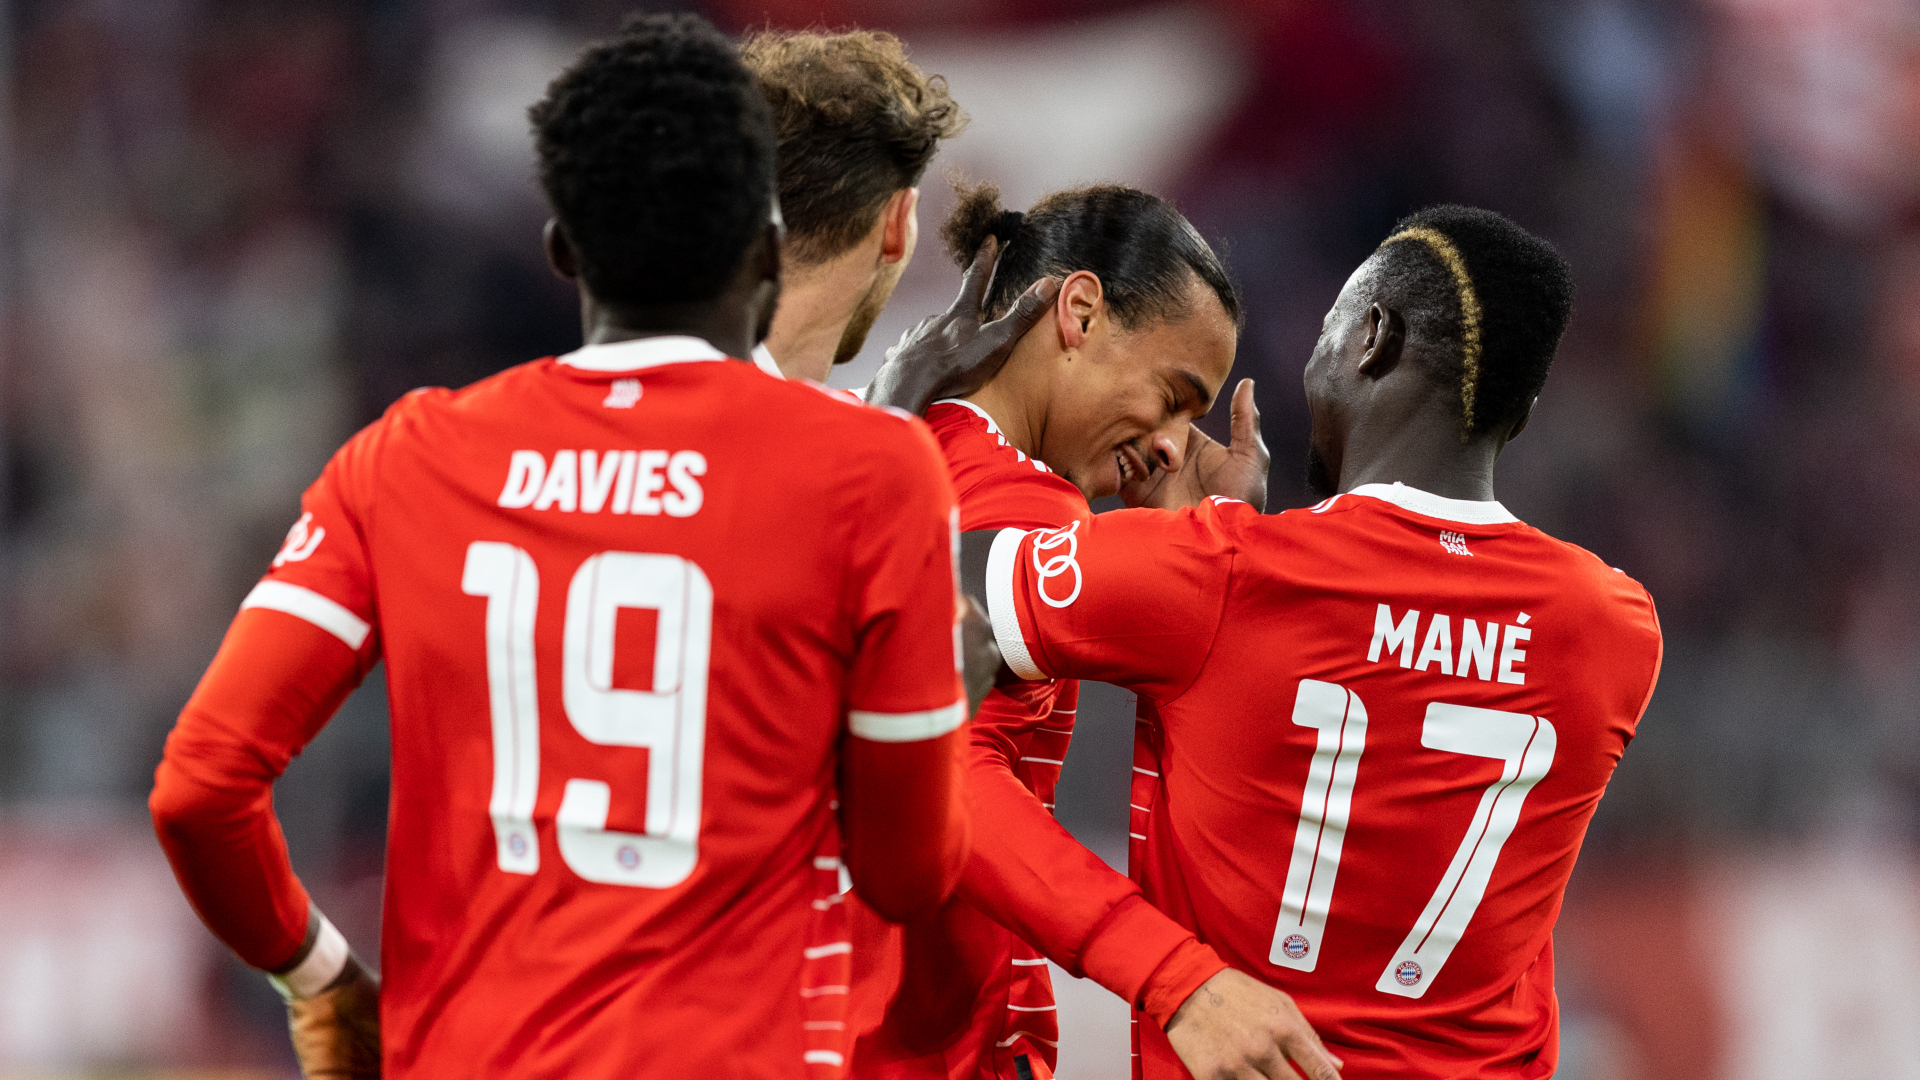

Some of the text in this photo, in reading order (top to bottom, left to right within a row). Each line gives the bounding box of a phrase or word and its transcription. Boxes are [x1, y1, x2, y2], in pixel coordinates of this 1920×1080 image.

[497, 449, 707, 518] DAVIES
[1439, 530, 1466, 545] MIA
[1366, 603, 1532, 686] MANÉ
[460, 540, 714, 890] 19
[1268, 678, 1557, 999] 17
